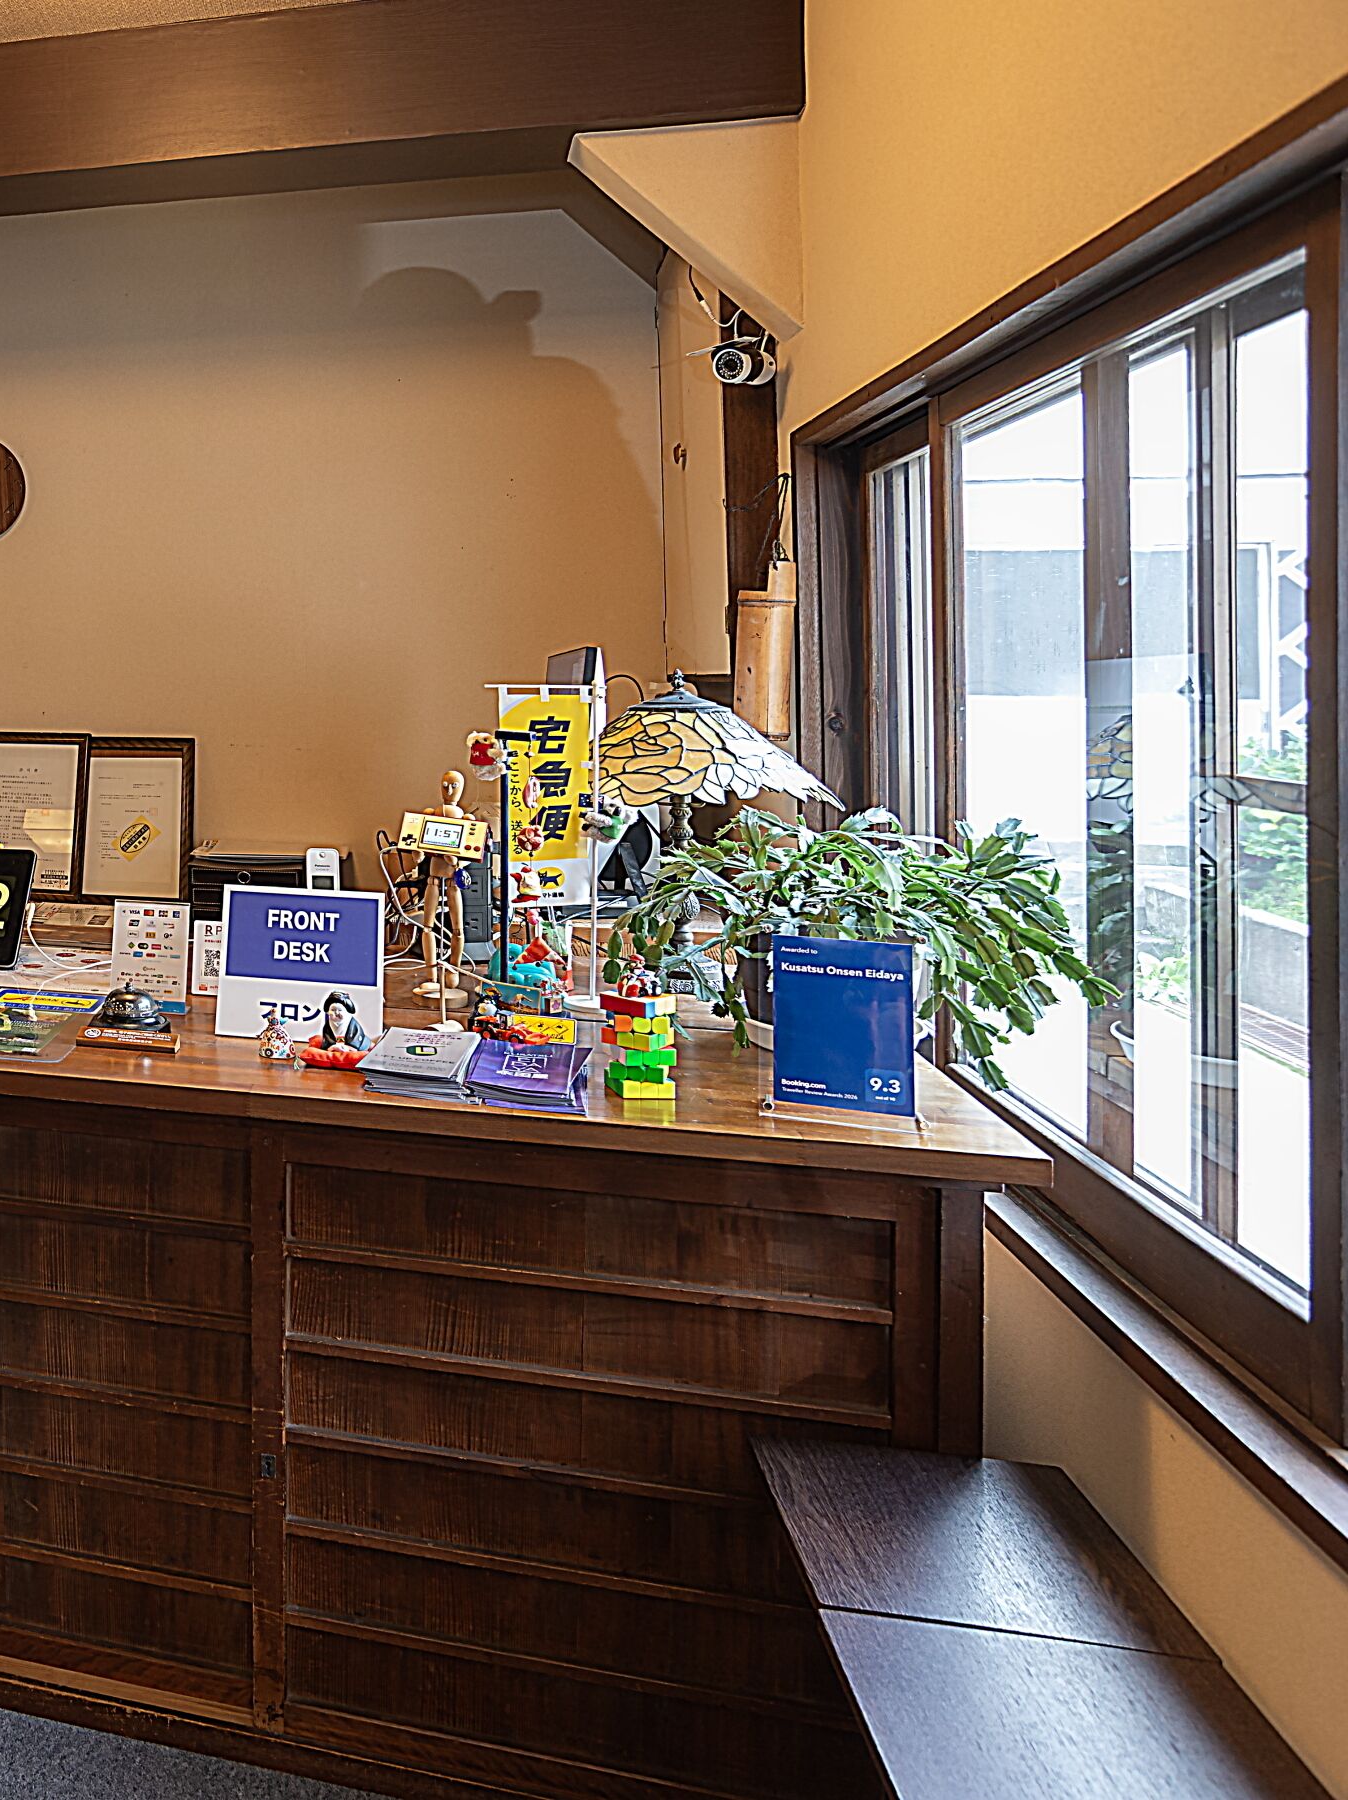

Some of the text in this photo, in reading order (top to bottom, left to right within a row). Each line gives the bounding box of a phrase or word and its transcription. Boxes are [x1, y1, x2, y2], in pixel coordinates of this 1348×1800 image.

[528, 715, 572, 841] 宅急便
[426, 827, 460, 839] 11:57
[267, 908, 340, 932] FRONT
[272, 940, 330, 963] DESK
[780, 946, 809, 954] Awarded
[781, 962, 904, 982] Kusatsu Onsen Eidaya
[259, 1001, 330, 1026] フロン
[781, 1078, 827, 1090] Booking.com
[782, 1086, 804, 1094] Traveller
[869, 1077, 901, 1093] 9.3
